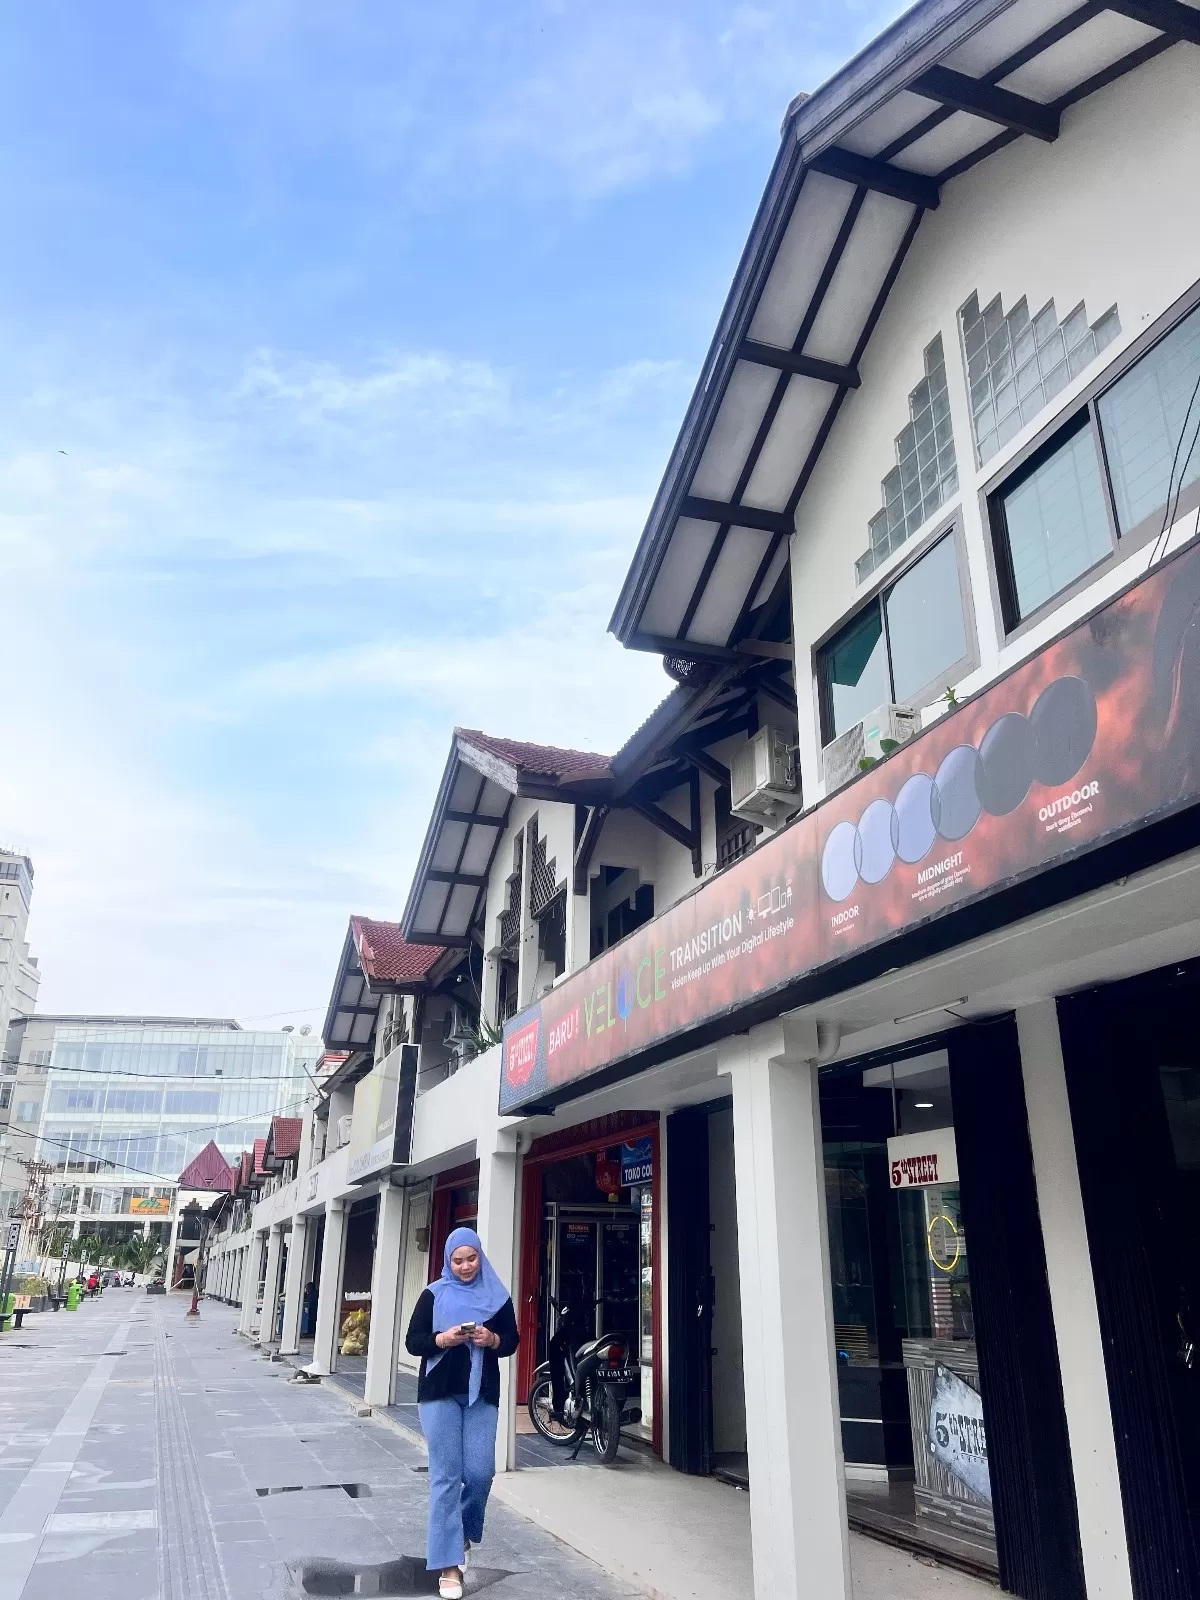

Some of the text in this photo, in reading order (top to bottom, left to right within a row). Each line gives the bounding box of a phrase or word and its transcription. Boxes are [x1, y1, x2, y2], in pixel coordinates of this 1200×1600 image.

[1038, 780, 1100, 822] OUTDOOR
[917, 851, 964, 885] MIDNIGHT
[830, 905, 860, 928] INDOOR
[669, 910, 743, 972] TRANSITION
[671, 916, 795, 991] Vision Keep Up With Your Digital Lifestyle
[548, 1014, 573, 1056] BARU
[624, 1165, 641, 1182] TOKO
